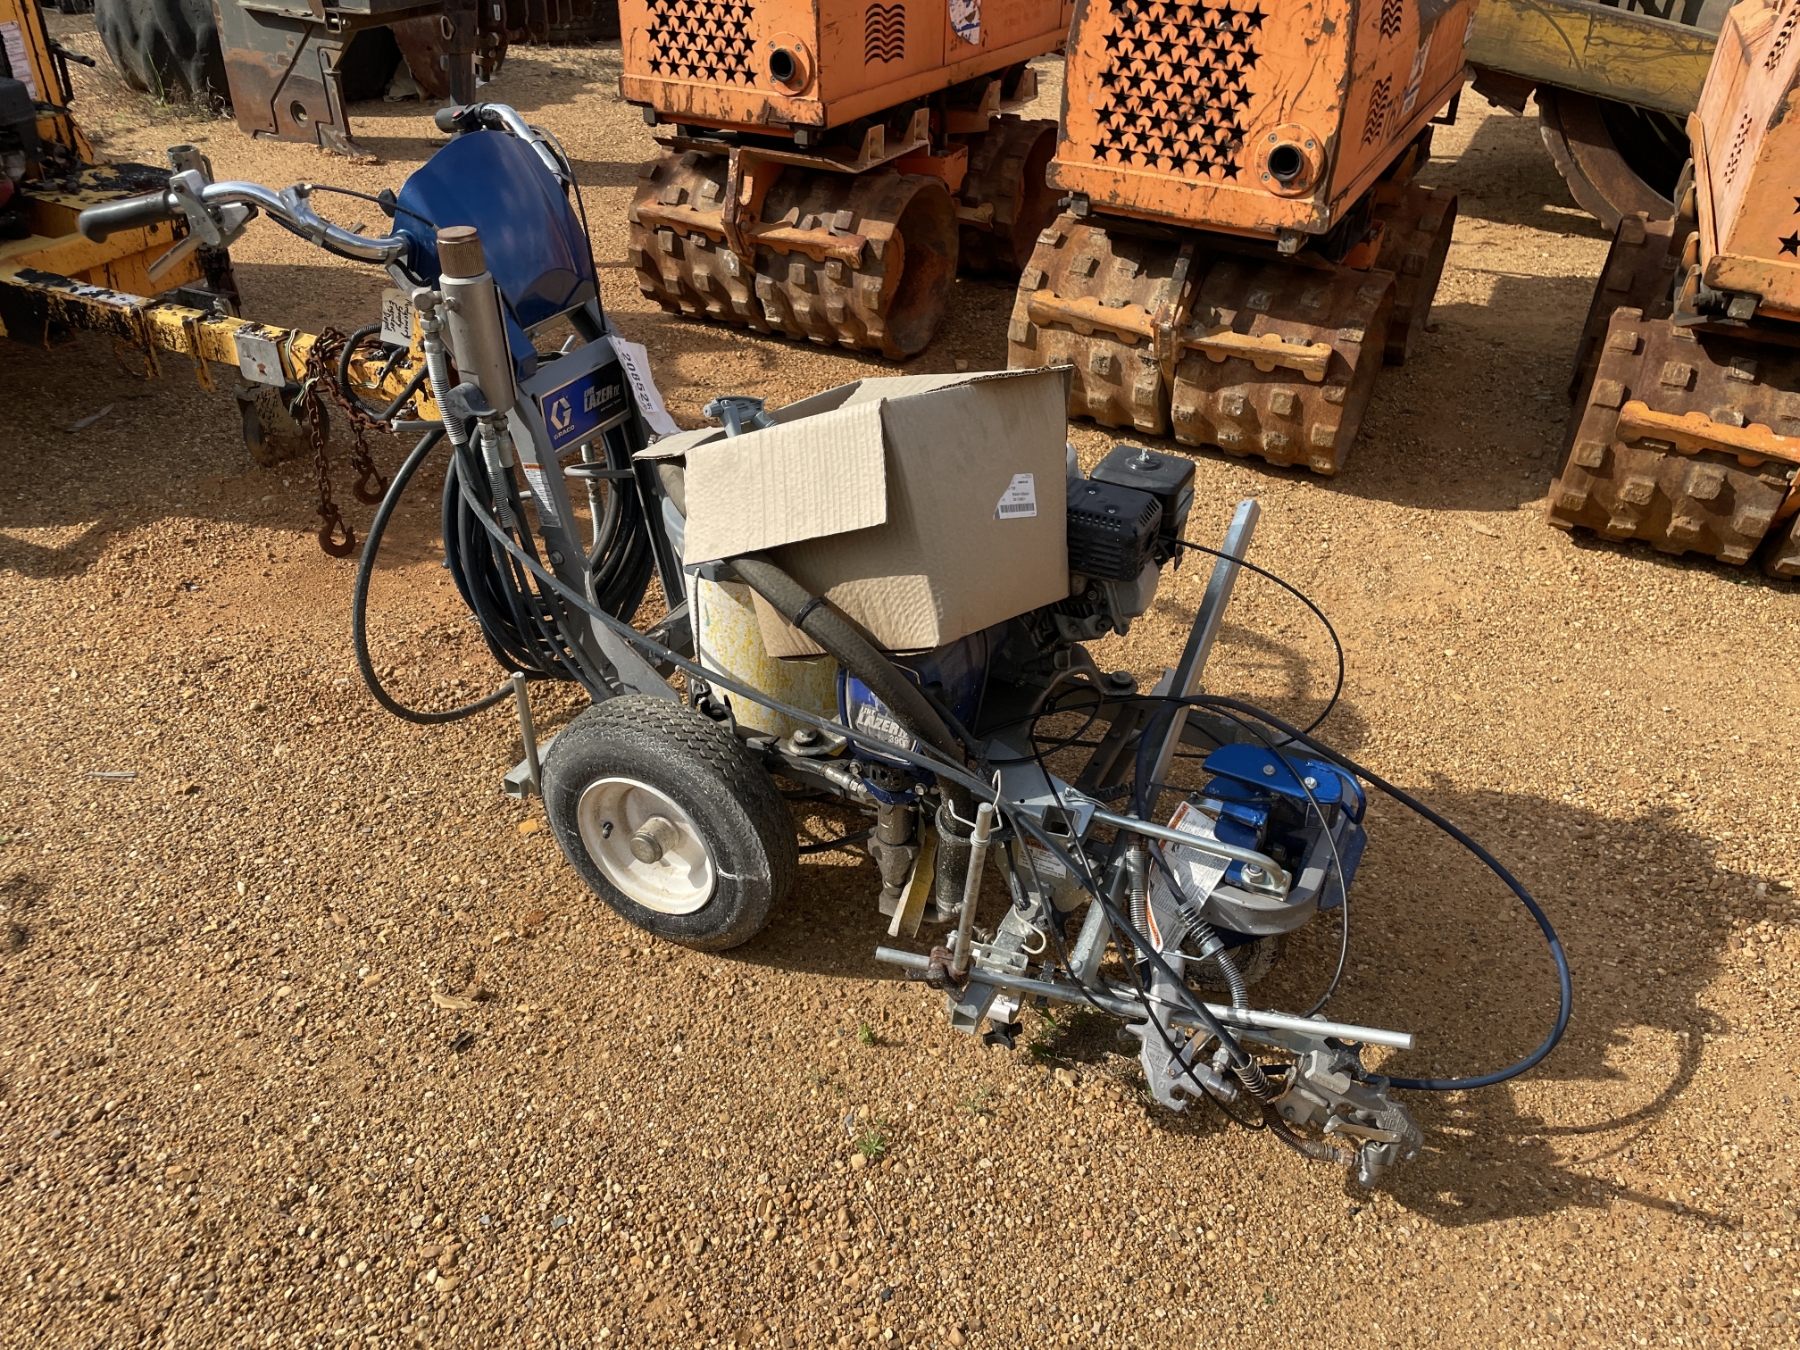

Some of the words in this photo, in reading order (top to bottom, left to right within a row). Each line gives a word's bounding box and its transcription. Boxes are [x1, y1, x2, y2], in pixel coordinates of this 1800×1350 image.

[583, 385, 614, 413] LAZER
[553, 424, 575, 440] GRACO
[856, 713, 900, 736] LAZER
